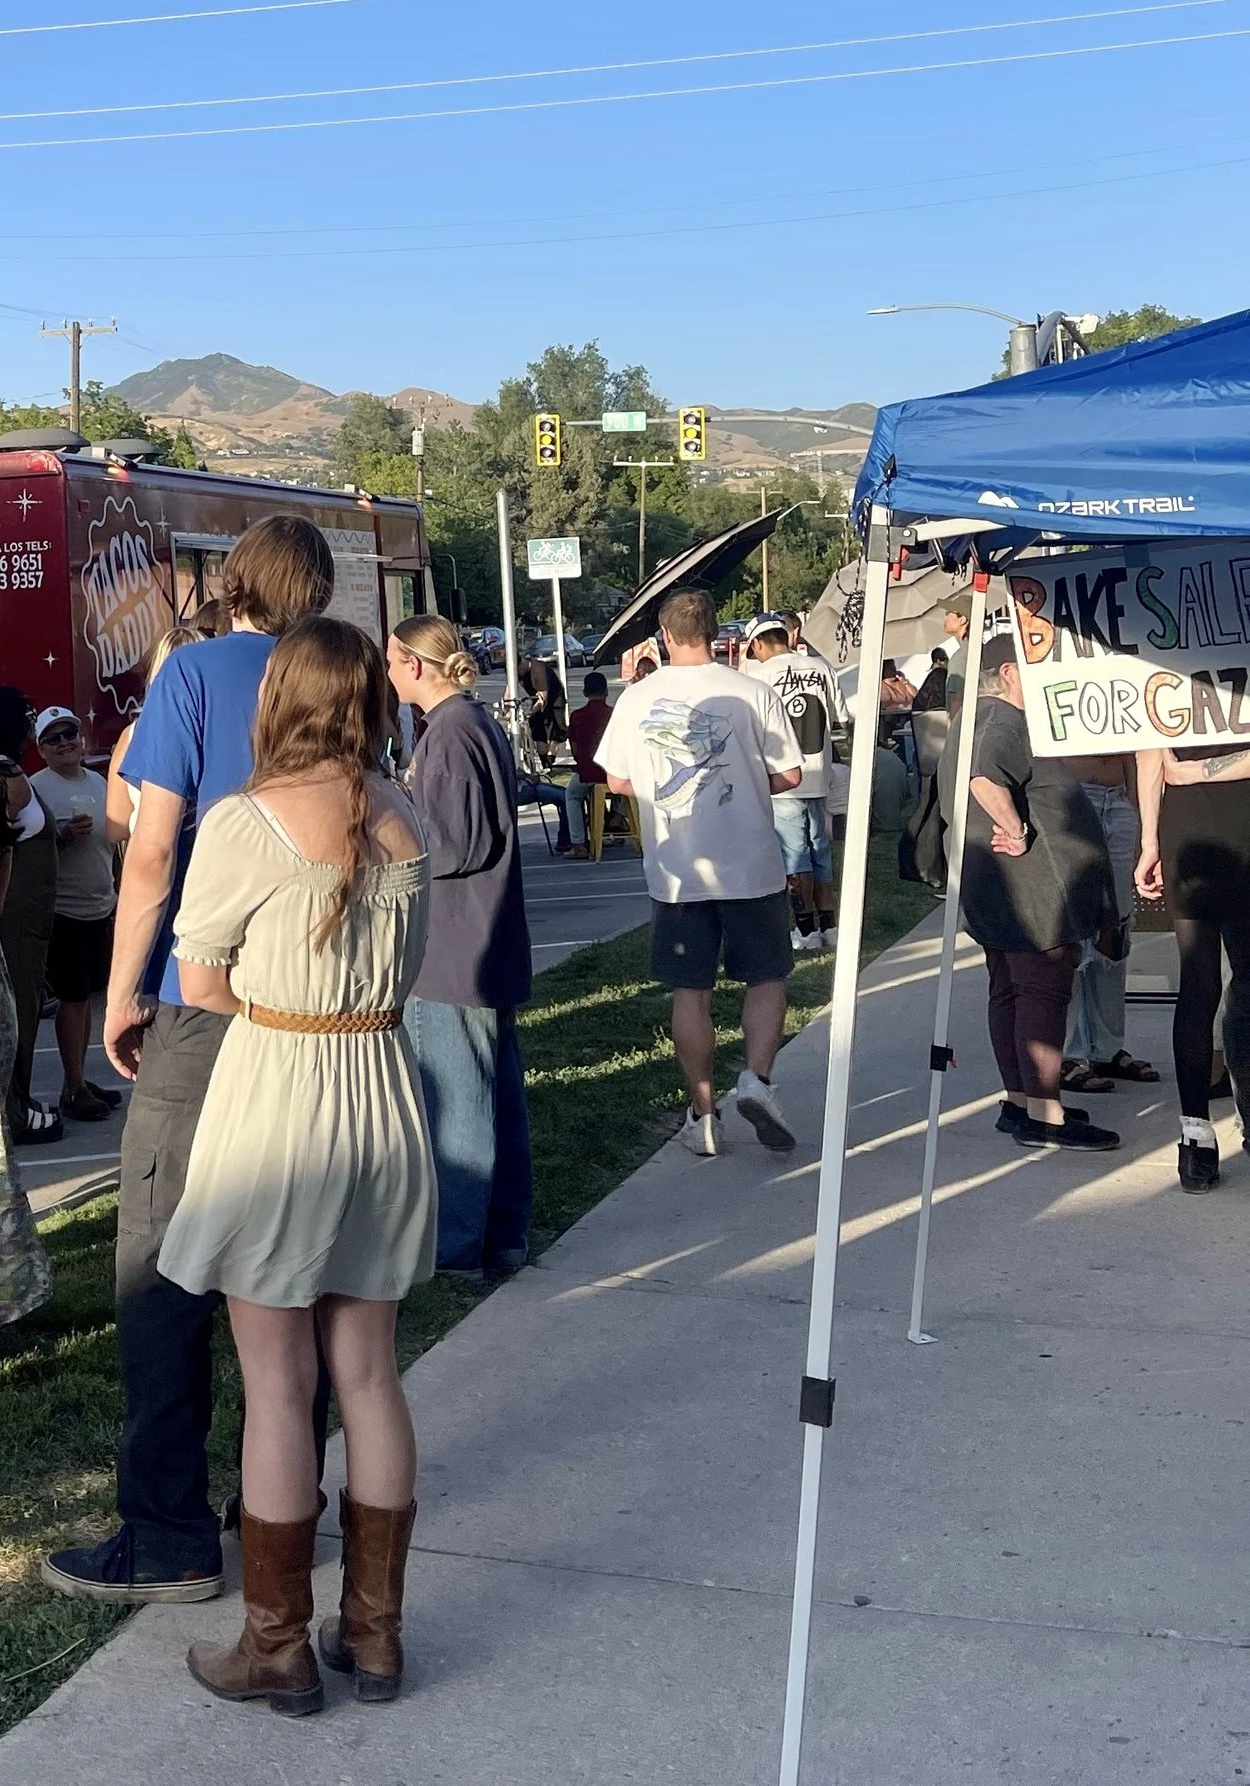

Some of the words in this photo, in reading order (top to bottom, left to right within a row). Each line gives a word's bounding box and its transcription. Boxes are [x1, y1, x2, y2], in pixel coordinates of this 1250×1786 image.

[1123, 496, 1194, 515] TRAIL
[4, 542, 23, 553] LOS
[11, 553, 42, 572] 9651
[11, 571, 44, 589] 9357
[88, 530, 152, 634] TACOS
[96, 586, 161, 678] DADDY
[1009, 566, 1139, 664] BAKE
[1044, 680, 1141, 741] FOR
